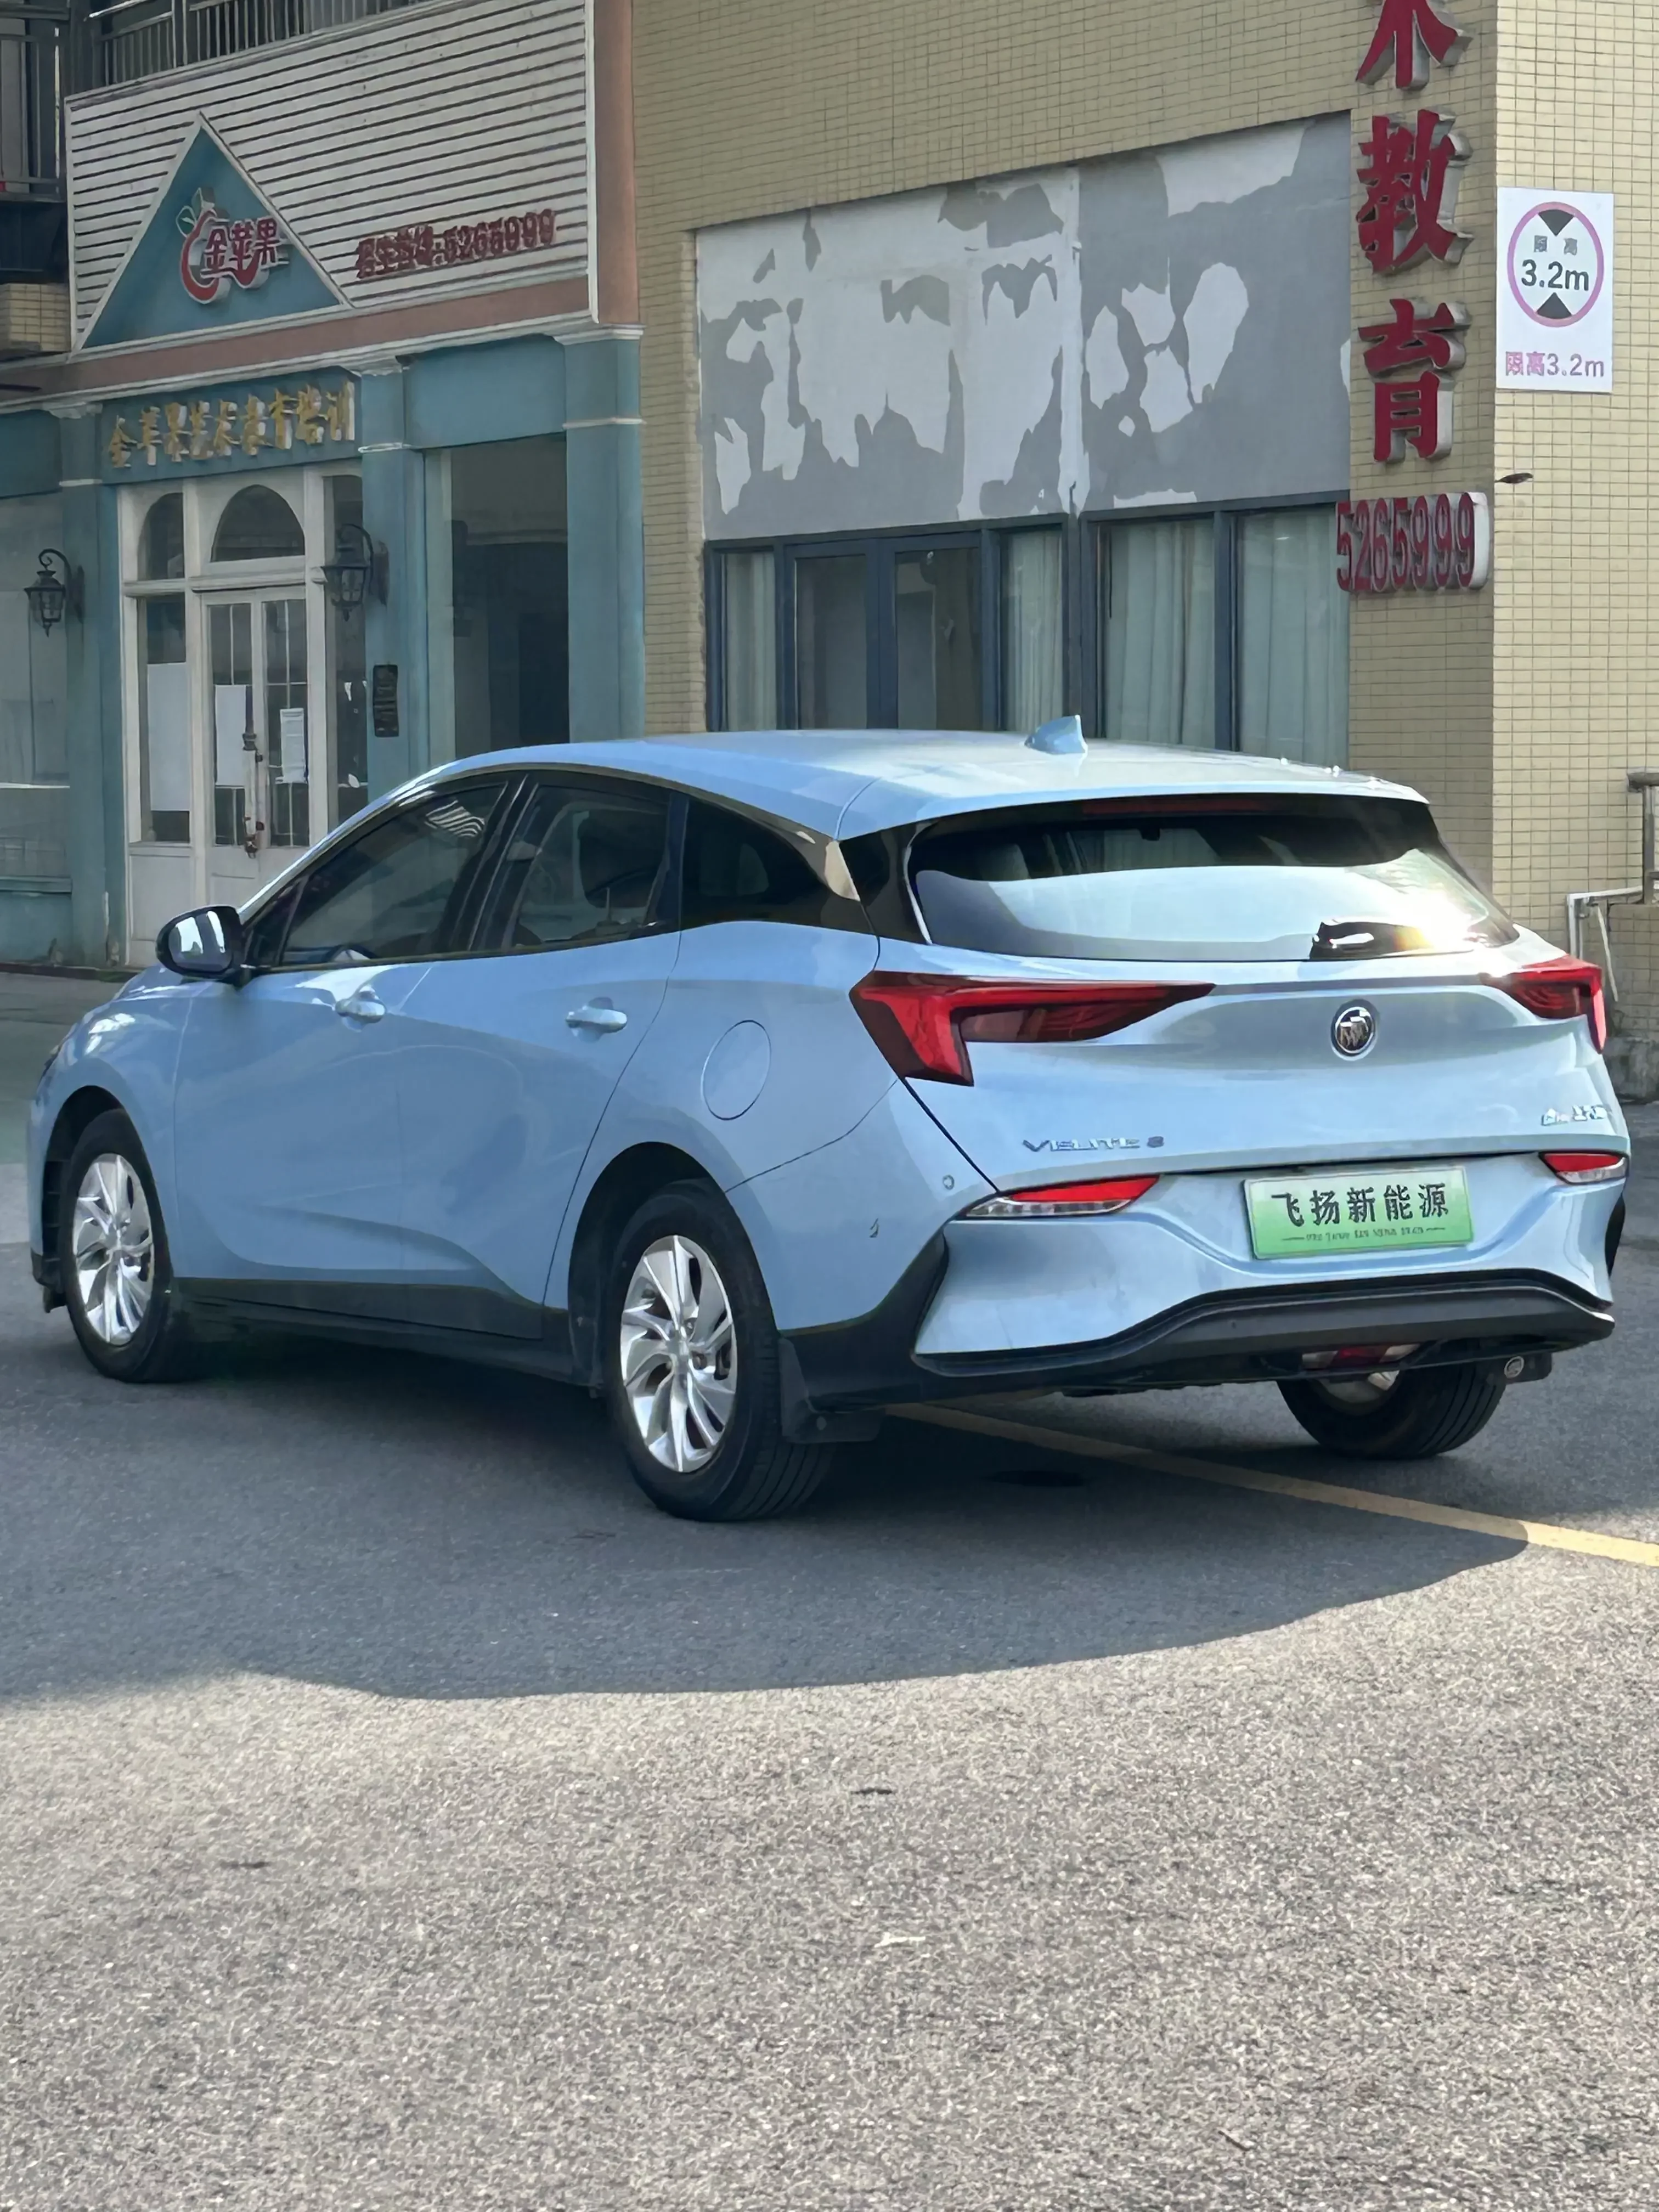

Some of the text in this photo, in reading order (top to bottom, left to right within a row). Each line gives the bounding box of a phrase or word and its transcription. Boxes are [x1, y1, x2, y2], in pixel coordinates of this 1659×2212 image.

[200, 217, 280, 279] 金苹果
[1521, 259, 1589, 291] 3.2m
[1336, 492, 1477, 592] 5265999
[1271, 1182, 1449, 1227] 飞扬新能源
